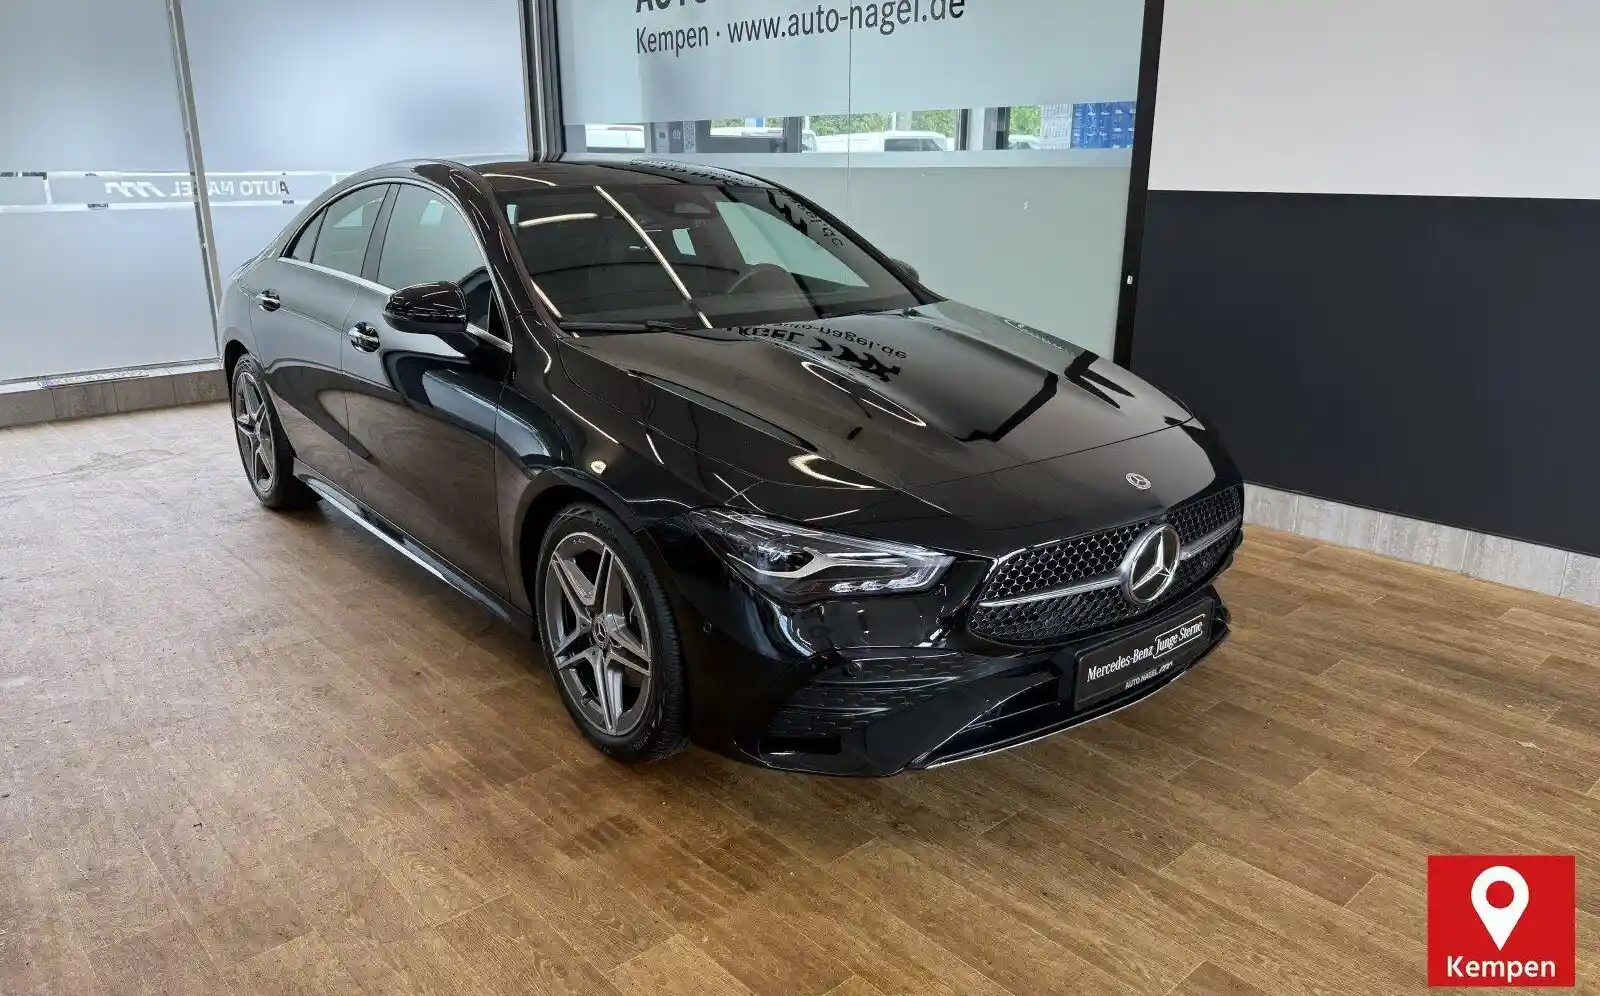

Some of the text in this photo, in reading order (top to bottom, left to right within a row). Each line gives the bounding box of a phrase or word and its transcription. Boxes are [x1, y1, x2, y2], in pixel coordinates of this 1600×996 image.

[636, 0, 965, 57] Kempen www.auto-nagel.de
[1086, 622, 1203, 683] Mercedes-Benz Junge Sterne
[1125, 669, 1158, 690] AUTO NAGEL
